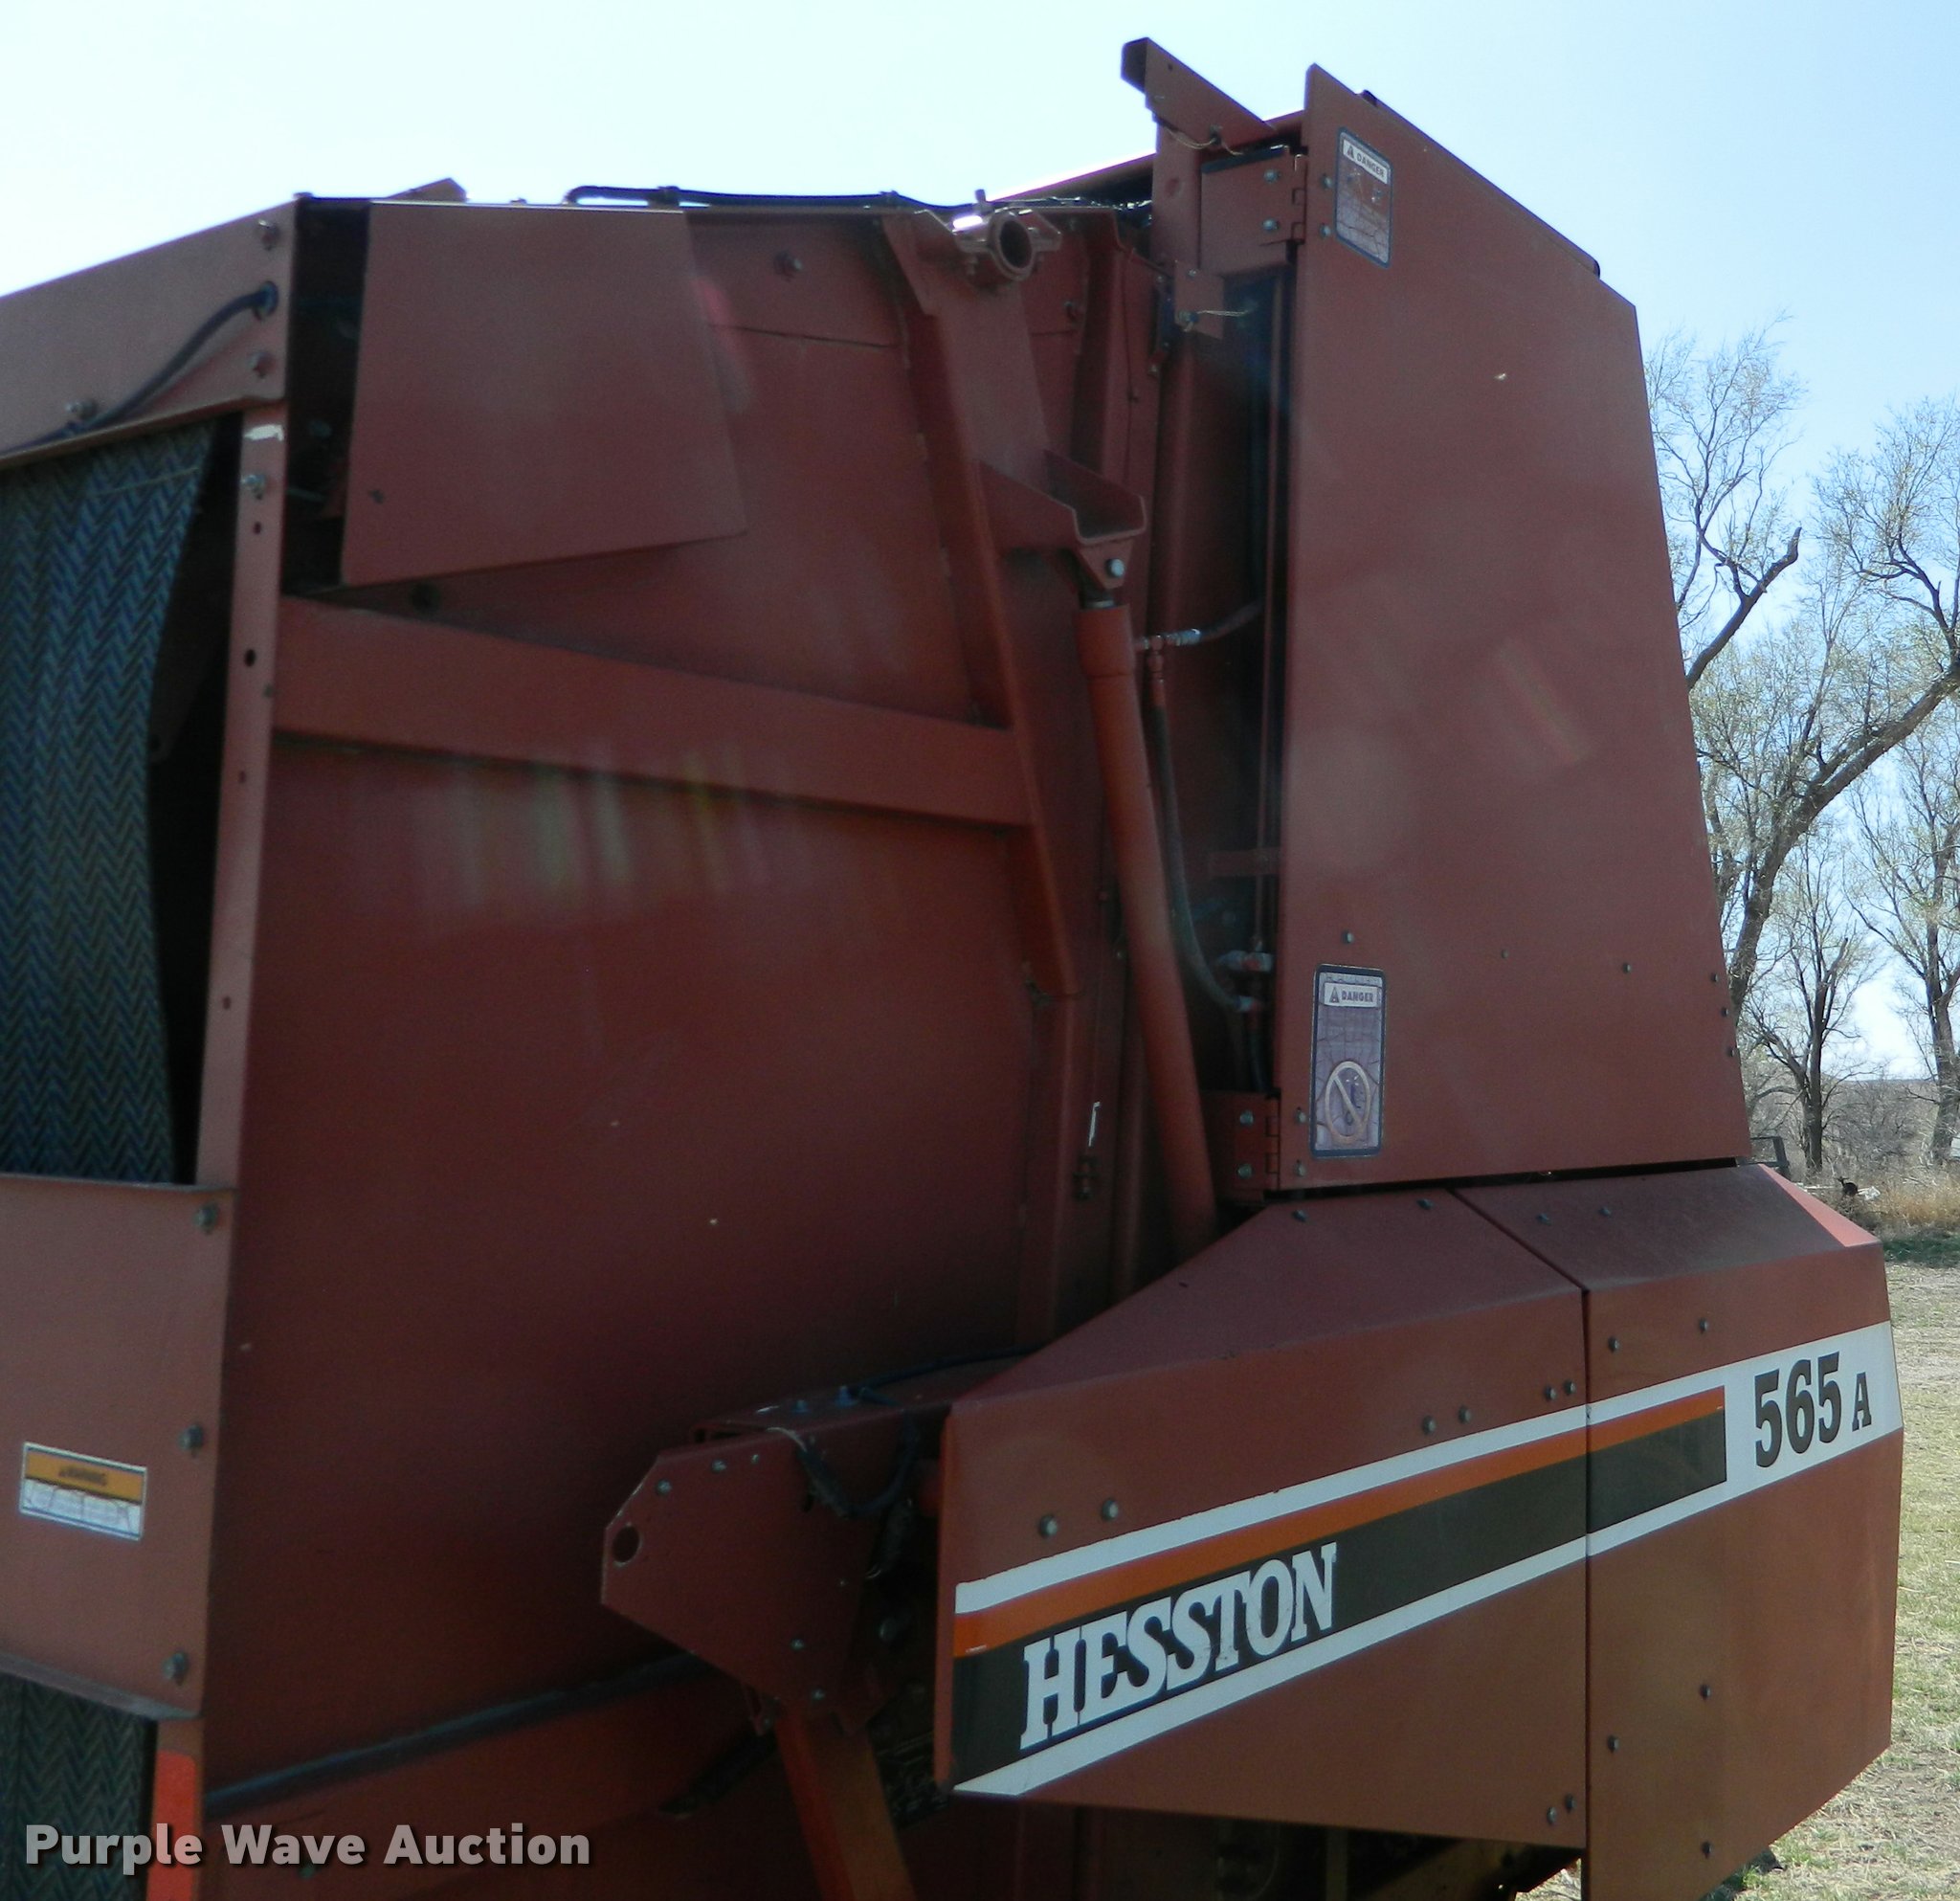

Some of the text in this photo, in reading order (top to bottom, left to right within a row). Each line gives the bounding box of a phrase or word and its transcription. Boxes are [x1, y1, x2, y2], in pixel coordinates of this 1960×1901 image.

[1356, 151, 1385, 178] DANGER
[1341, 990, 1374, 1003] DANGER
[1754, 1352, 1872, 1468] 565 A
[1020, 1541, 1337, 1750] HESSTON
